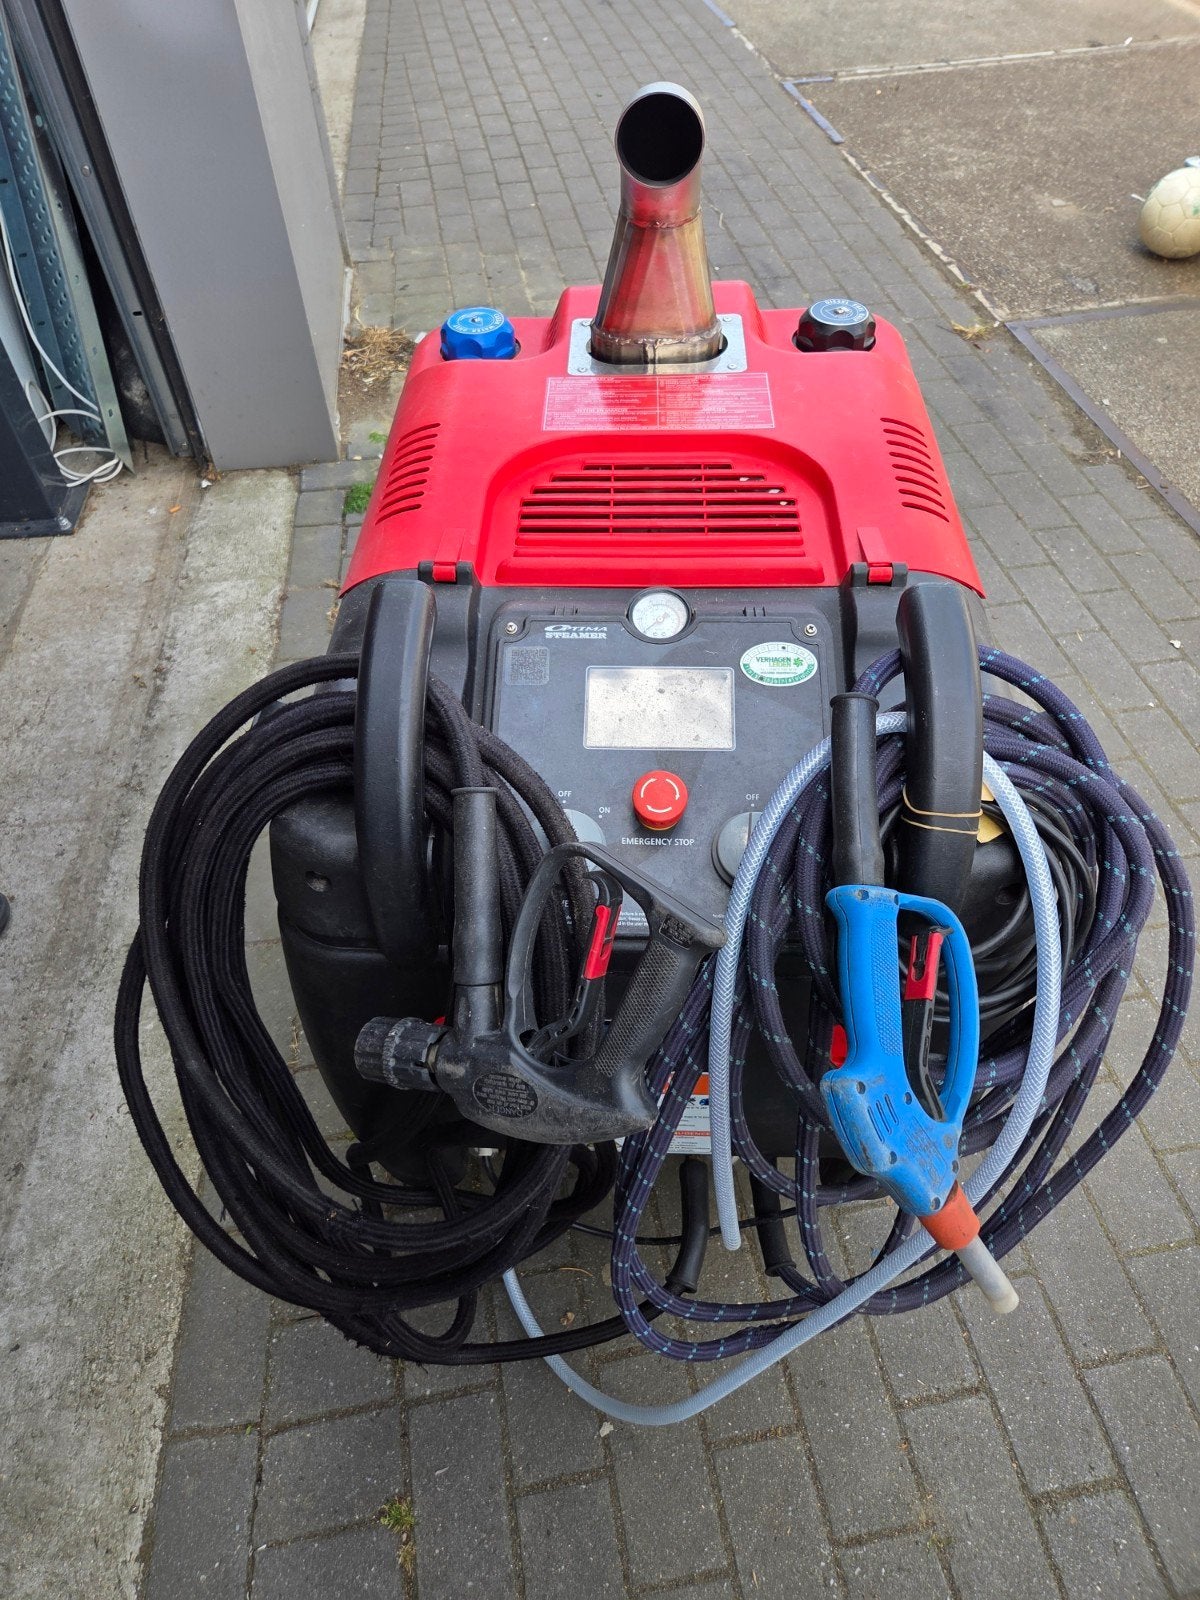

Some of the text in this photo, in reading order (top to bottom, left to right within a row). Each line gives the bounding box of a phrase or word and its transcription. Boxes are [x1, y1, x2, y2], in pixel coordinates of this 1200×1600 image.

[544, 624, 608, 632] OPTIMA
[545, 632, 607, 640] STEAMER
[558, 790, 572, 798] OFF
[745, 793, 760, 801] OFF
[599, 806, 610, 814] ON
[621, 837, 695, 846] EMERGENCY STOP
